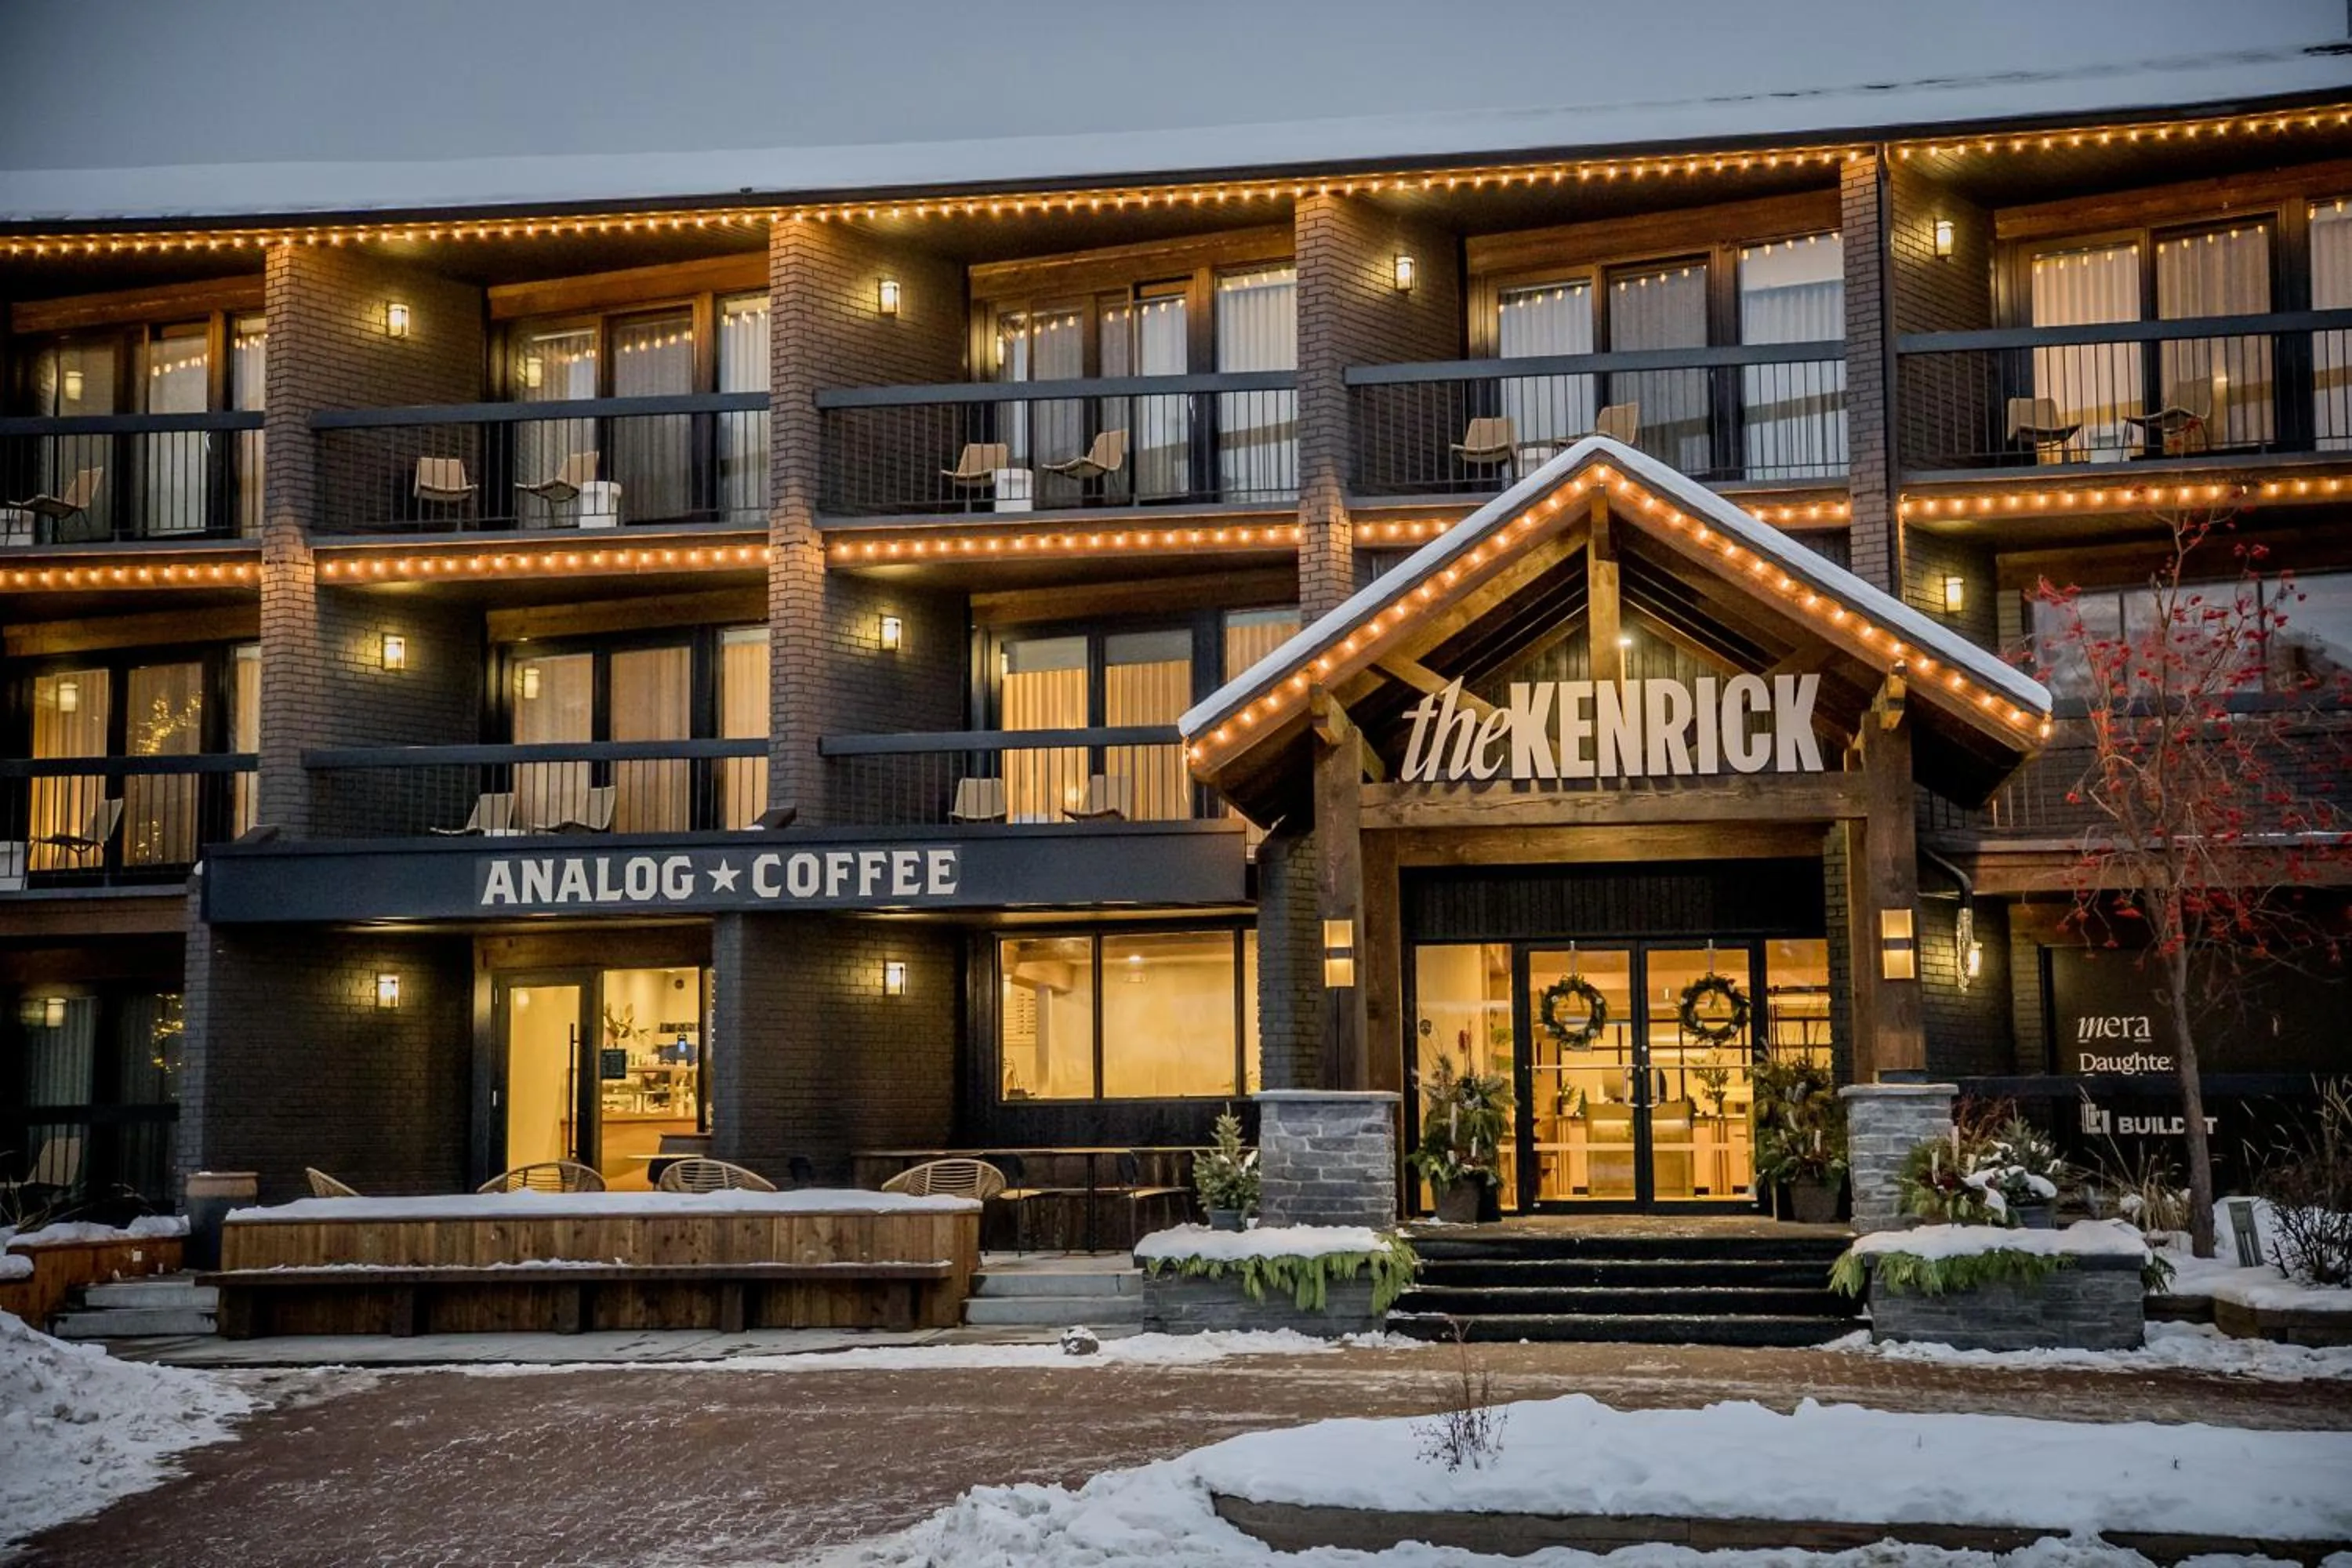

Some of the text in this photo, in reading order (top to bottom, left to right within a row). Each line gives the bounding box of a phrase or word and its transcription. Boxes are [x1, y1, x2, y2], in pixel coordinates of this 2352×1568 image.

[1401, 673, 1824, 782] the KENRICK
[481, 849, 958, 905] ANALOG COFFEE
[2078, 1016, 2152, 1043] mera
[2078, 1051, 2174, 1075] Daughte
